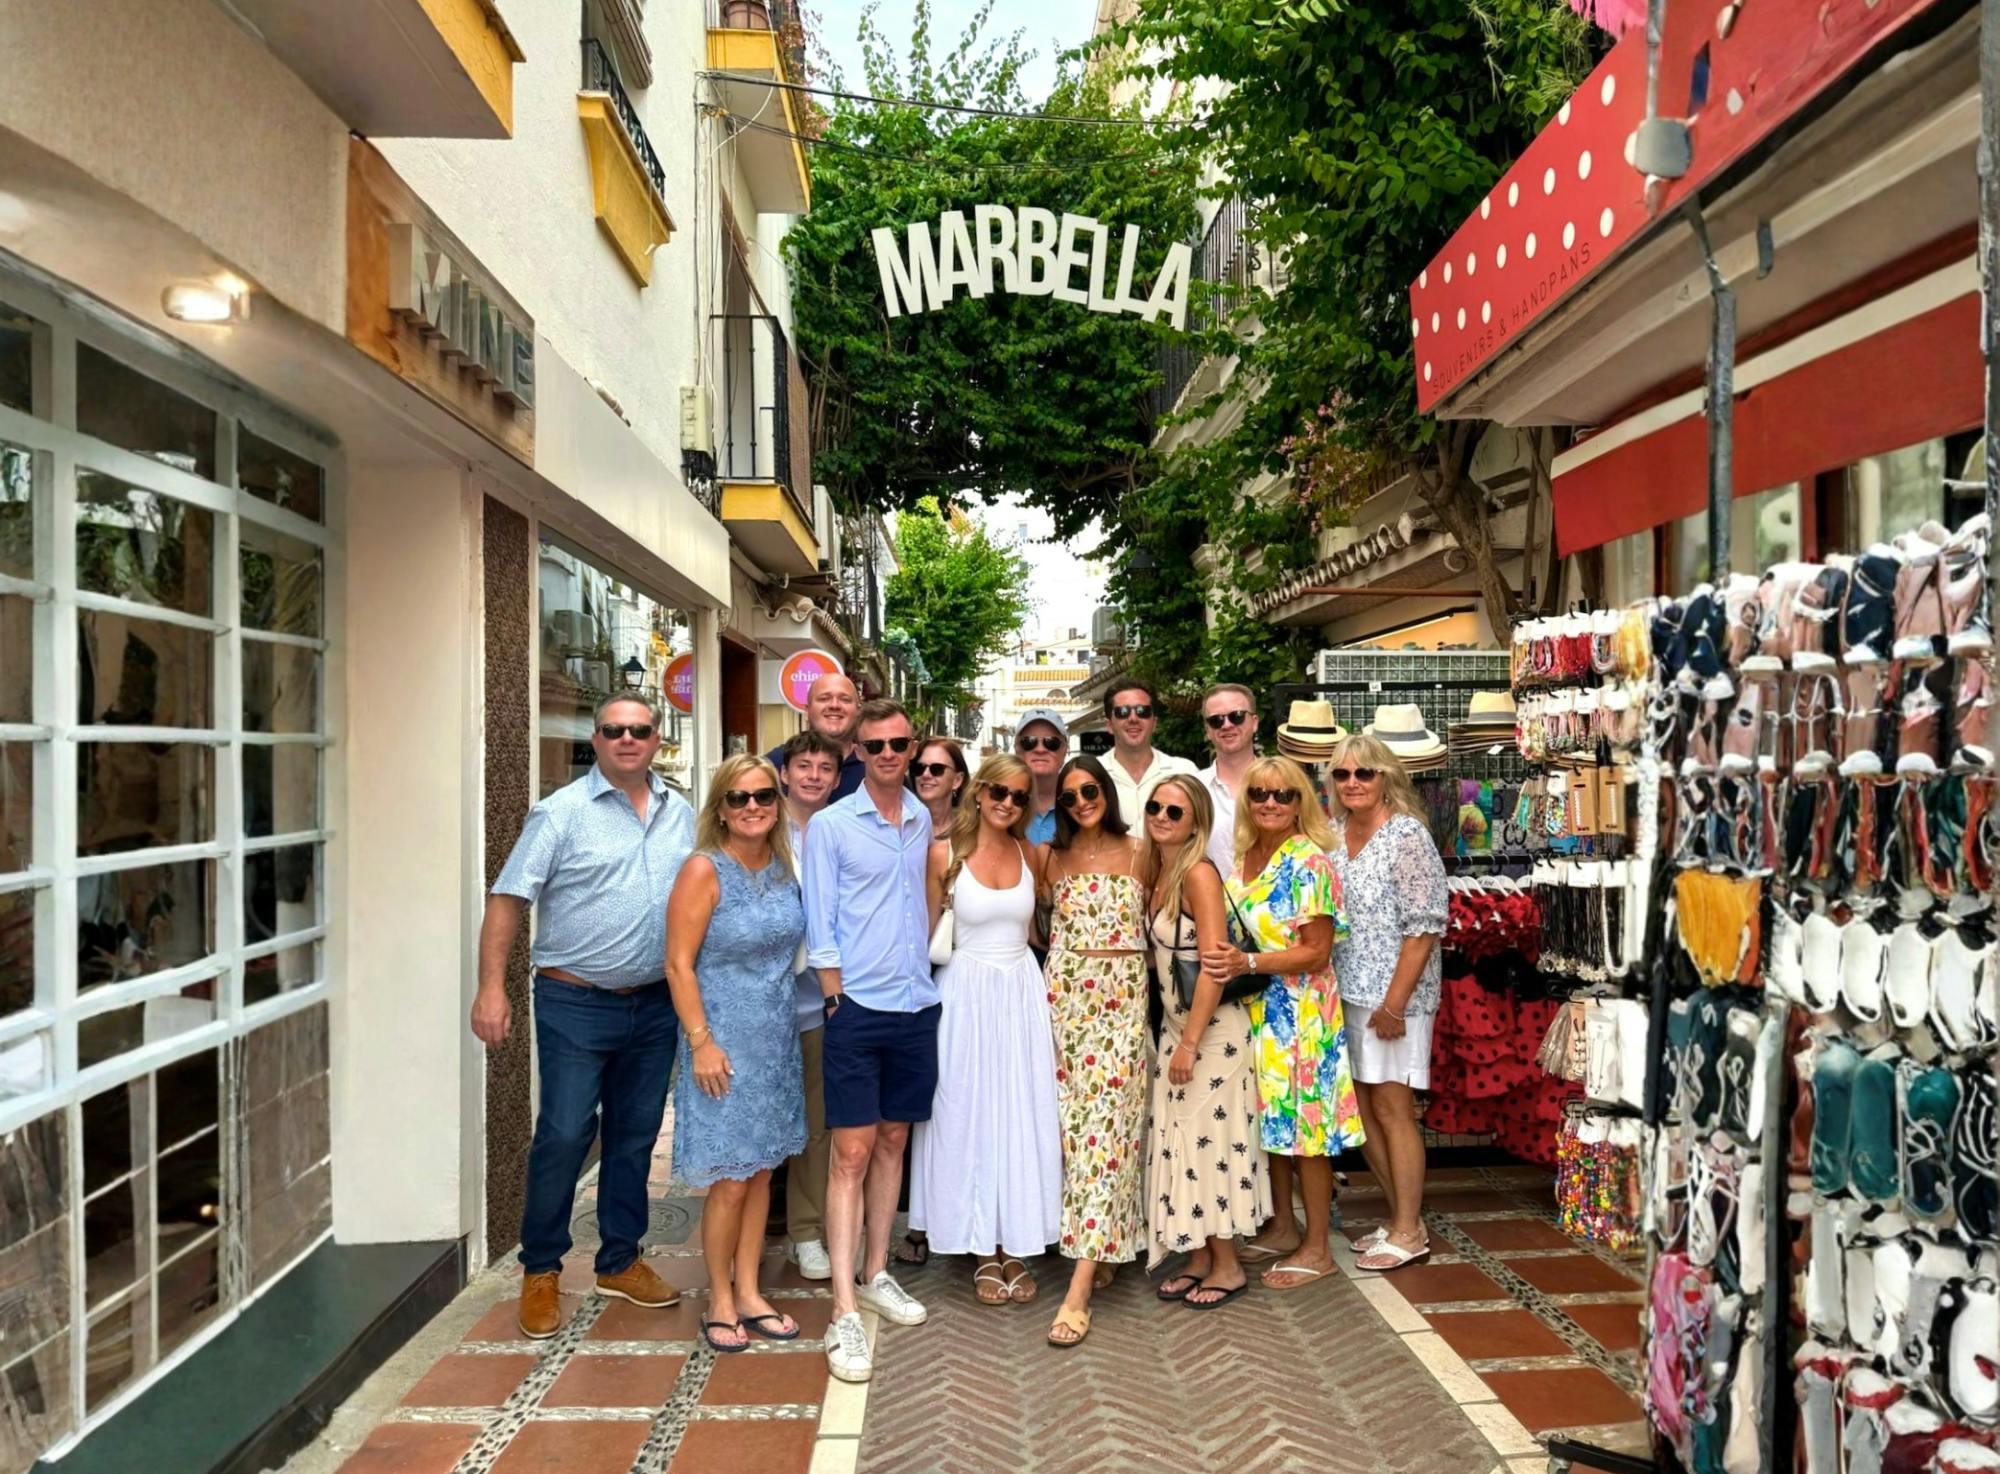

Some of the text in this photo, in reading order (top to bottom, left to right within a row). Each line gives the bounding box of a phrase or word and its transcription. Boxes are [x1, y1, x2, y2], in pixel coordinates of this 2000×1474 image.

[390, 223, 534, 410] MINE
[871, 203, 1193, 332] MARBELLA
[1432, 242, 1592, 394] SOUVENIRS & HANDPANS
